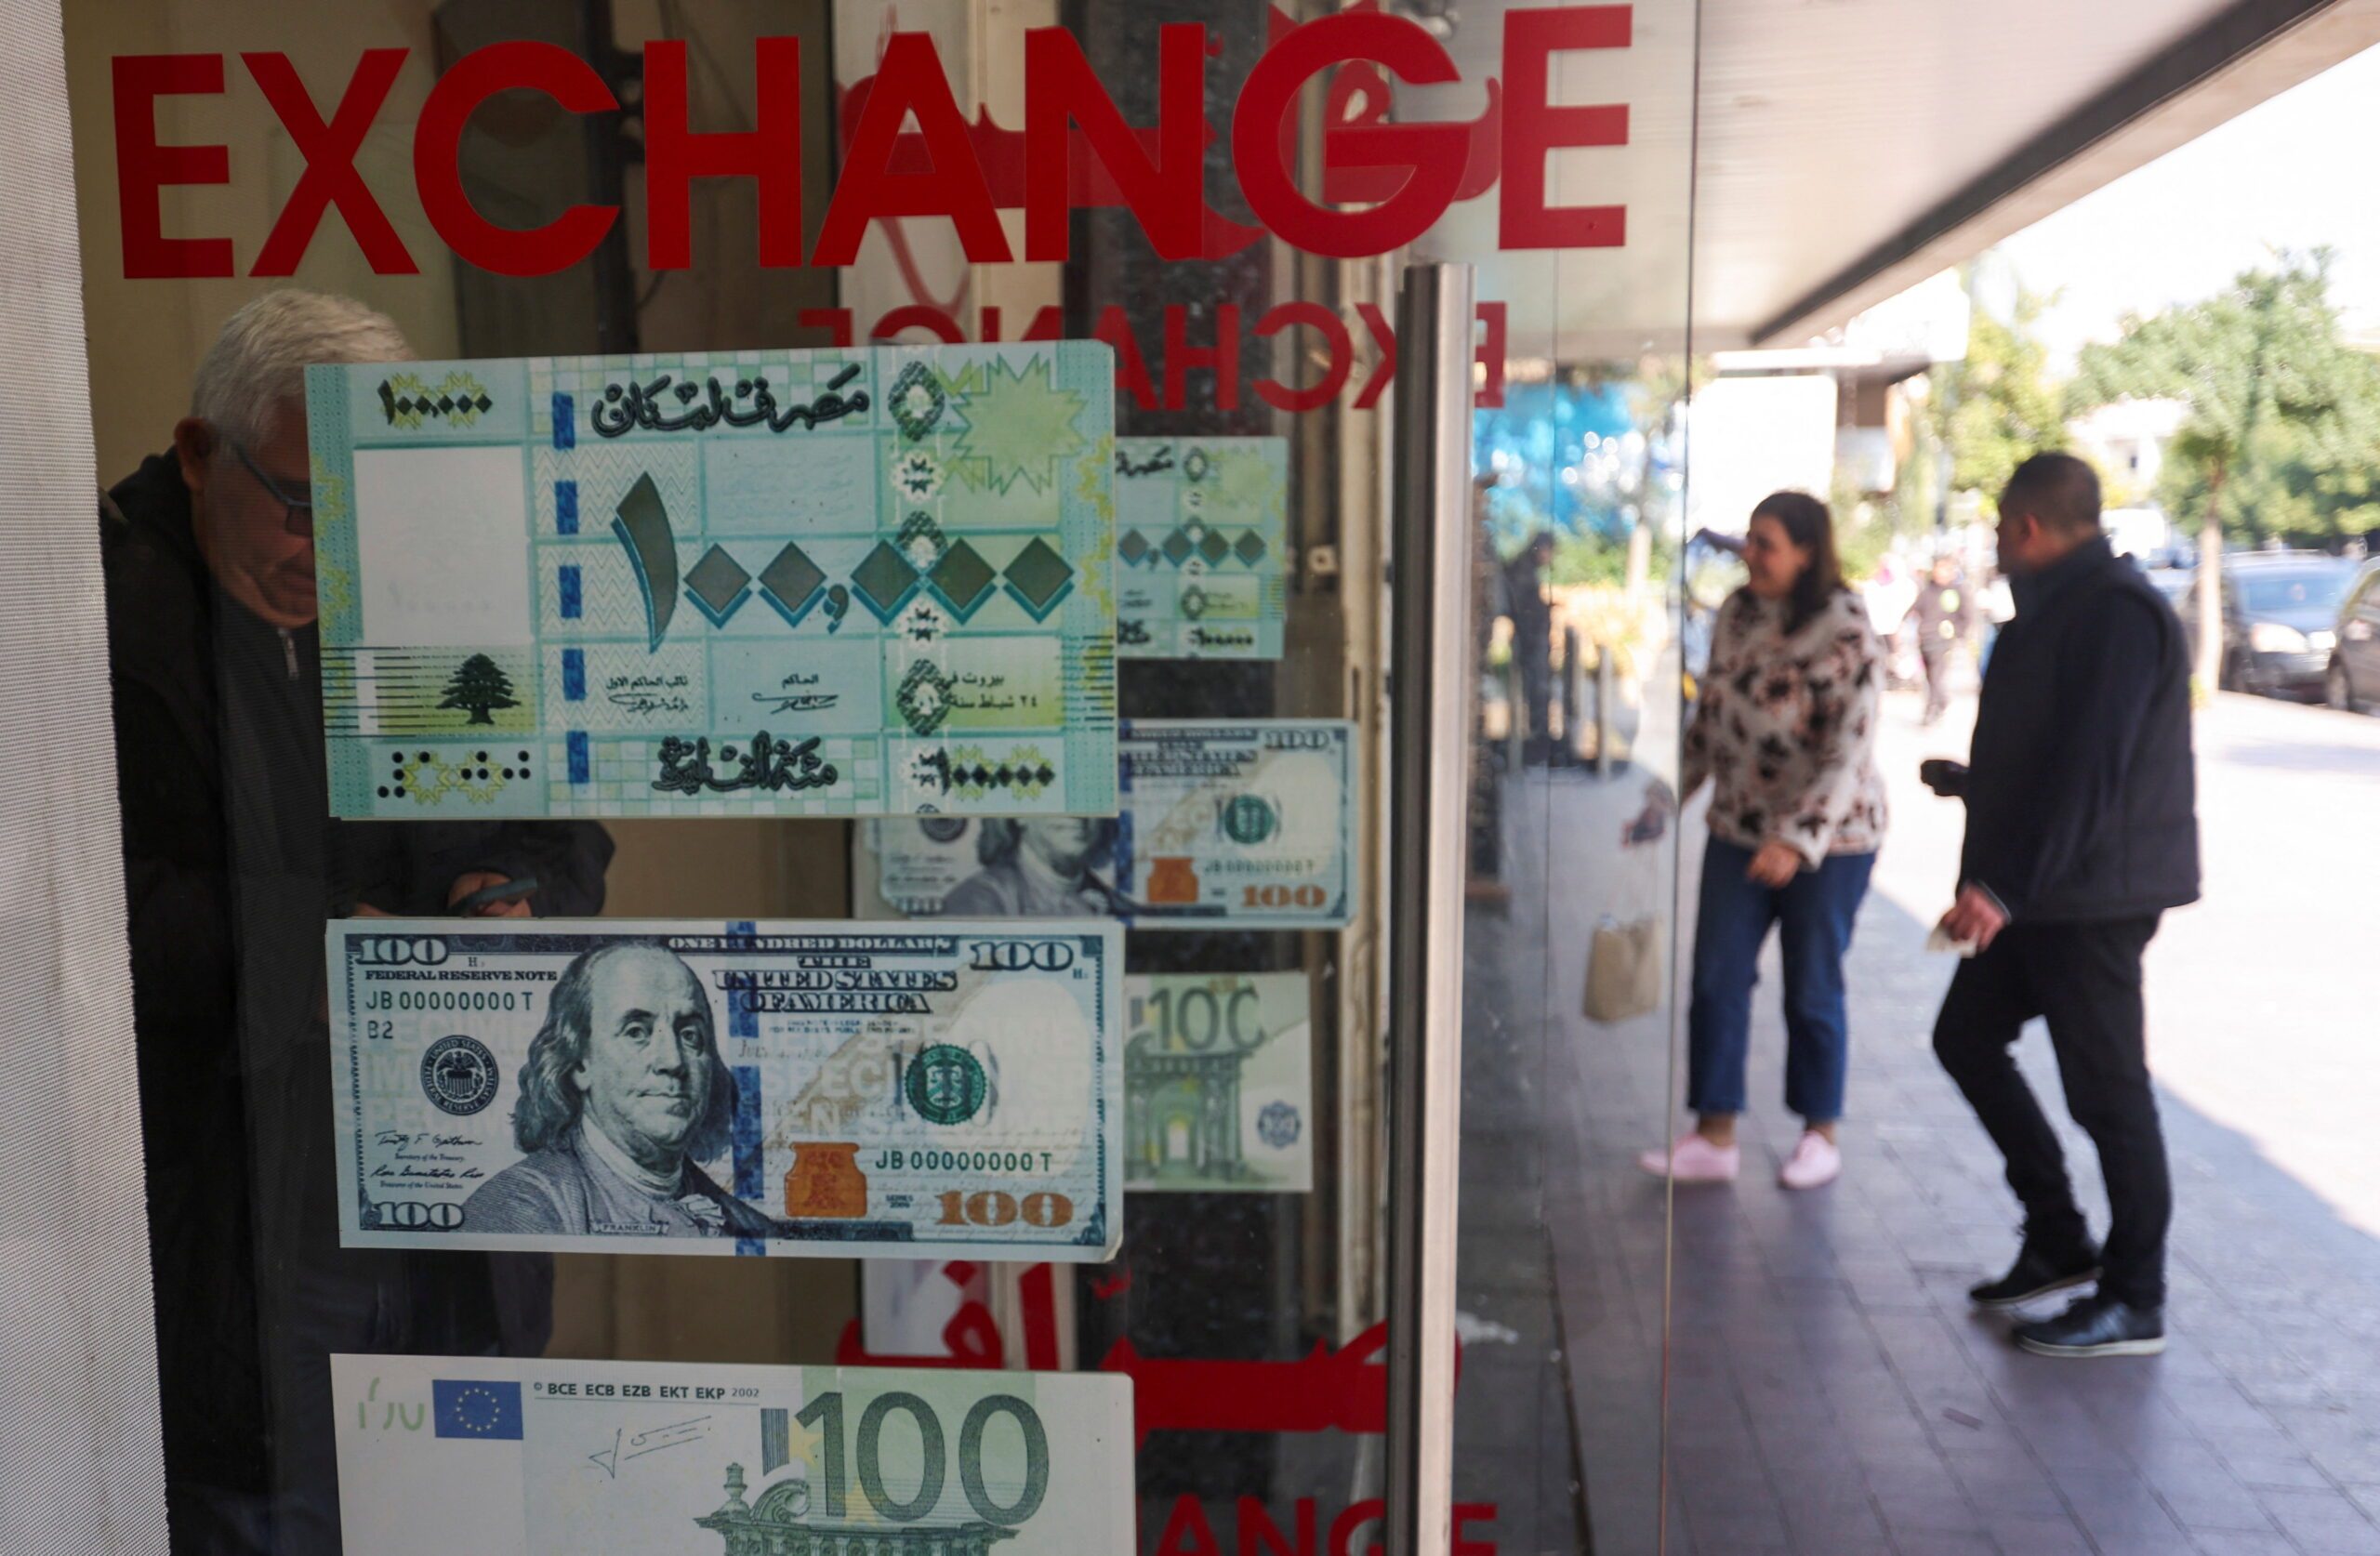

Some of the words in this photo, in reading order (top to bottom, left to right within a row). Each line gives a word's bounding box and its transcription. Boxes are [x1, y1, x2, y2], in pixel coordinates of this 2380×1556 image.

[112, 5, 1633, 279] EXCHANGE
[1243, 884, 1327, 908] 100
[356, 938, 450, 966] 100
[668, 937, 710, 949] ONE
[839, 937, 952, 951] DOLLARS
[798, 956, 871, 969] THE
[970, 941, 1075, 971] 100
[364, 970, 438, 982] FEDERAL
[438, 970, 512, 982] RESERVE
[513, 970, 558, 982] NOTE
[712, 969, 834, 991] UNITED
[835, 969, 958, 992] STATES
[365, 991, 392, 1010] JB
[399, 991, 515, 1011] 00000000
[521, 992, 533, 1010] T
[740, 992, 783, 1012] OF
[783, 992, 932, 1013] AMERICA
[367, 1021, 394, 1039] B2
[876, 1151, 904, 1170] JB
[910, 1151, 1034, 1172] 00000000
[1039, 1152, 1053, 1172] T
[373, 1201, 466, 1230] 100
[934, 1190, 1074, 1227] 100
[548, 1382, 577, 1395] BCE
[585, 1383, 615, 1396] ECB
[622, 1385, 652, 1397] EZB
[659, 1386, 690, 1398] EKT
[695, 1387, 726, 1400] EKP
[731, 1388, 760, 1398] 2002
[794, 1391, 1050, 1526] 100
